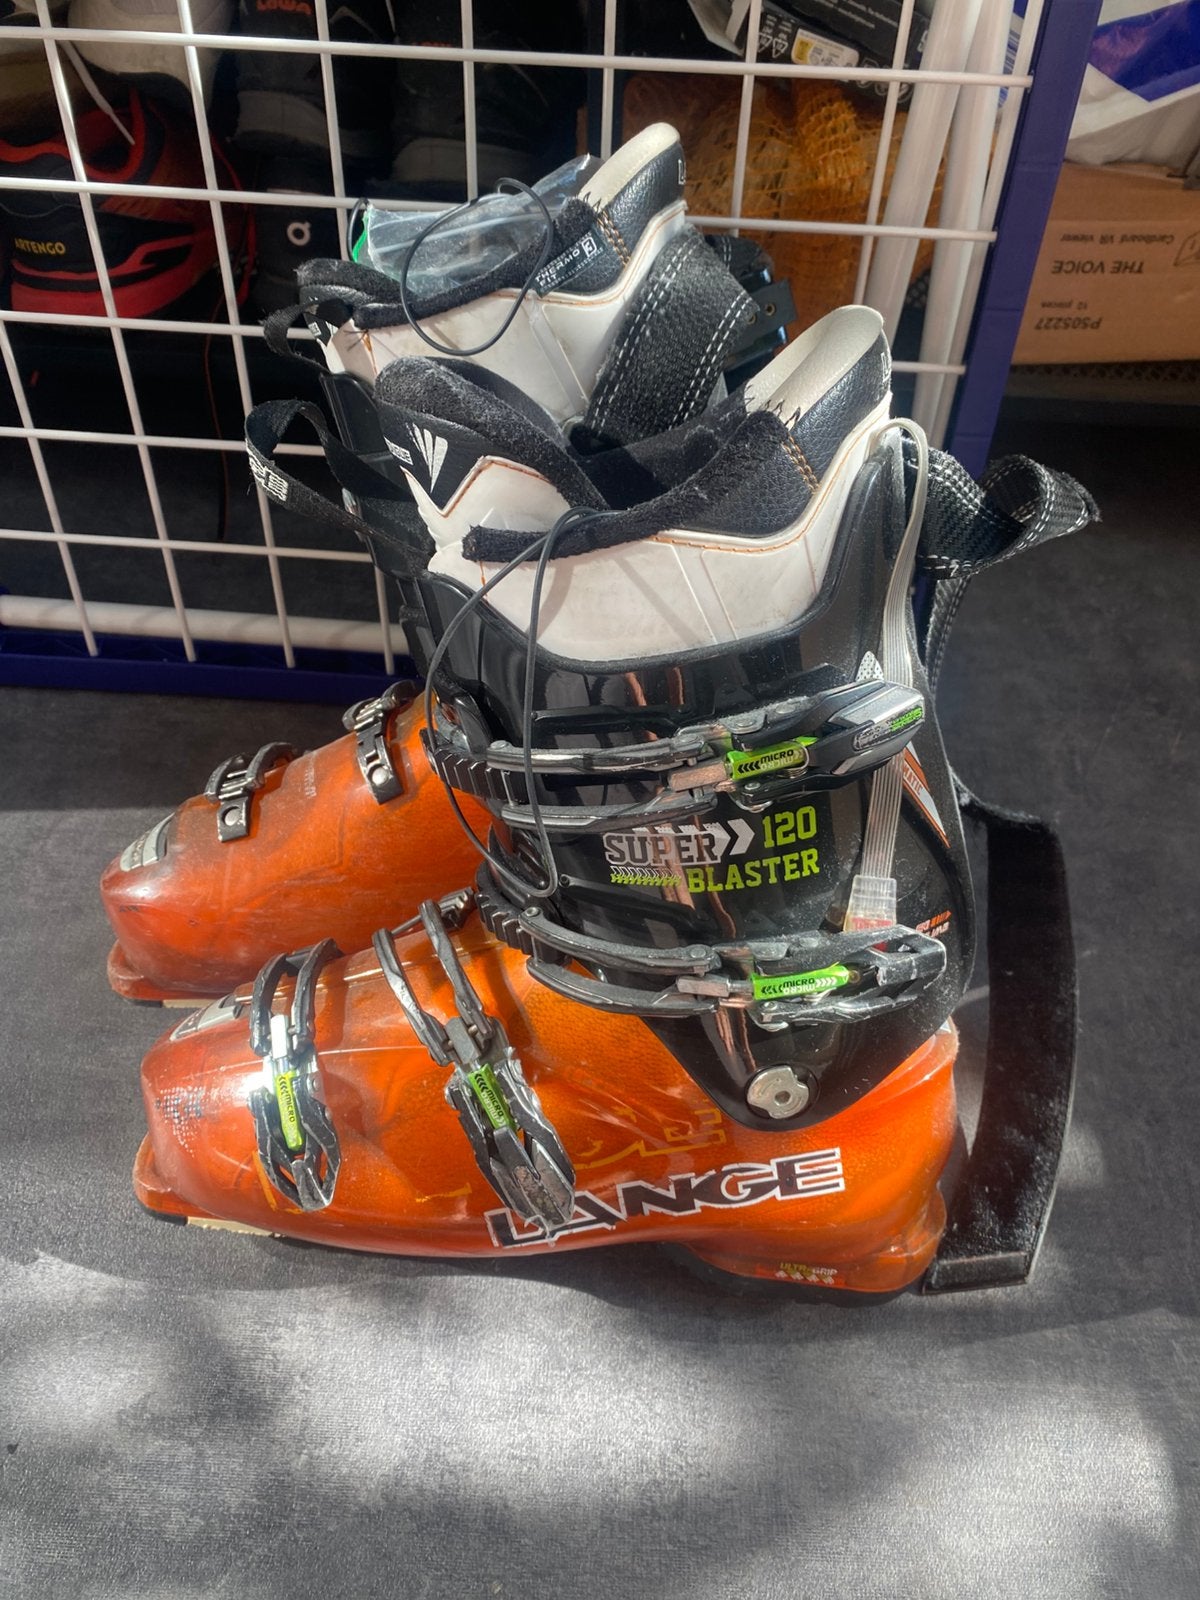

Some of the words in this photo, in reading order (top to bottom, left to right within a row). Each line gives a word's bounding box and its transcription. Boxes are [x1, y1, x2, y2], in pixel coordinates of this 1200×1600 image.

[14, 238, 66, 255] ARTENGO
[1059, 234, 1095, 245] viewer
[1099, 234, 1114, 245] VR
[1118, 234, 1175, 246] Cardboard
[1051, 260, 1106, 275] VOICE
[1109, 260, 1145, 275] THE
[760, 749, 794, 764] MICRO
[602, 832, 721, 866] SUPER
[762, 806, 818, 848] 120
[686, 847, 820, 893] BLASTER
[782, 977, 816, 989] MICRO
[487, 1089, 505, 1117] MICRO
[484, 1147, 845, 1248] LANGE
